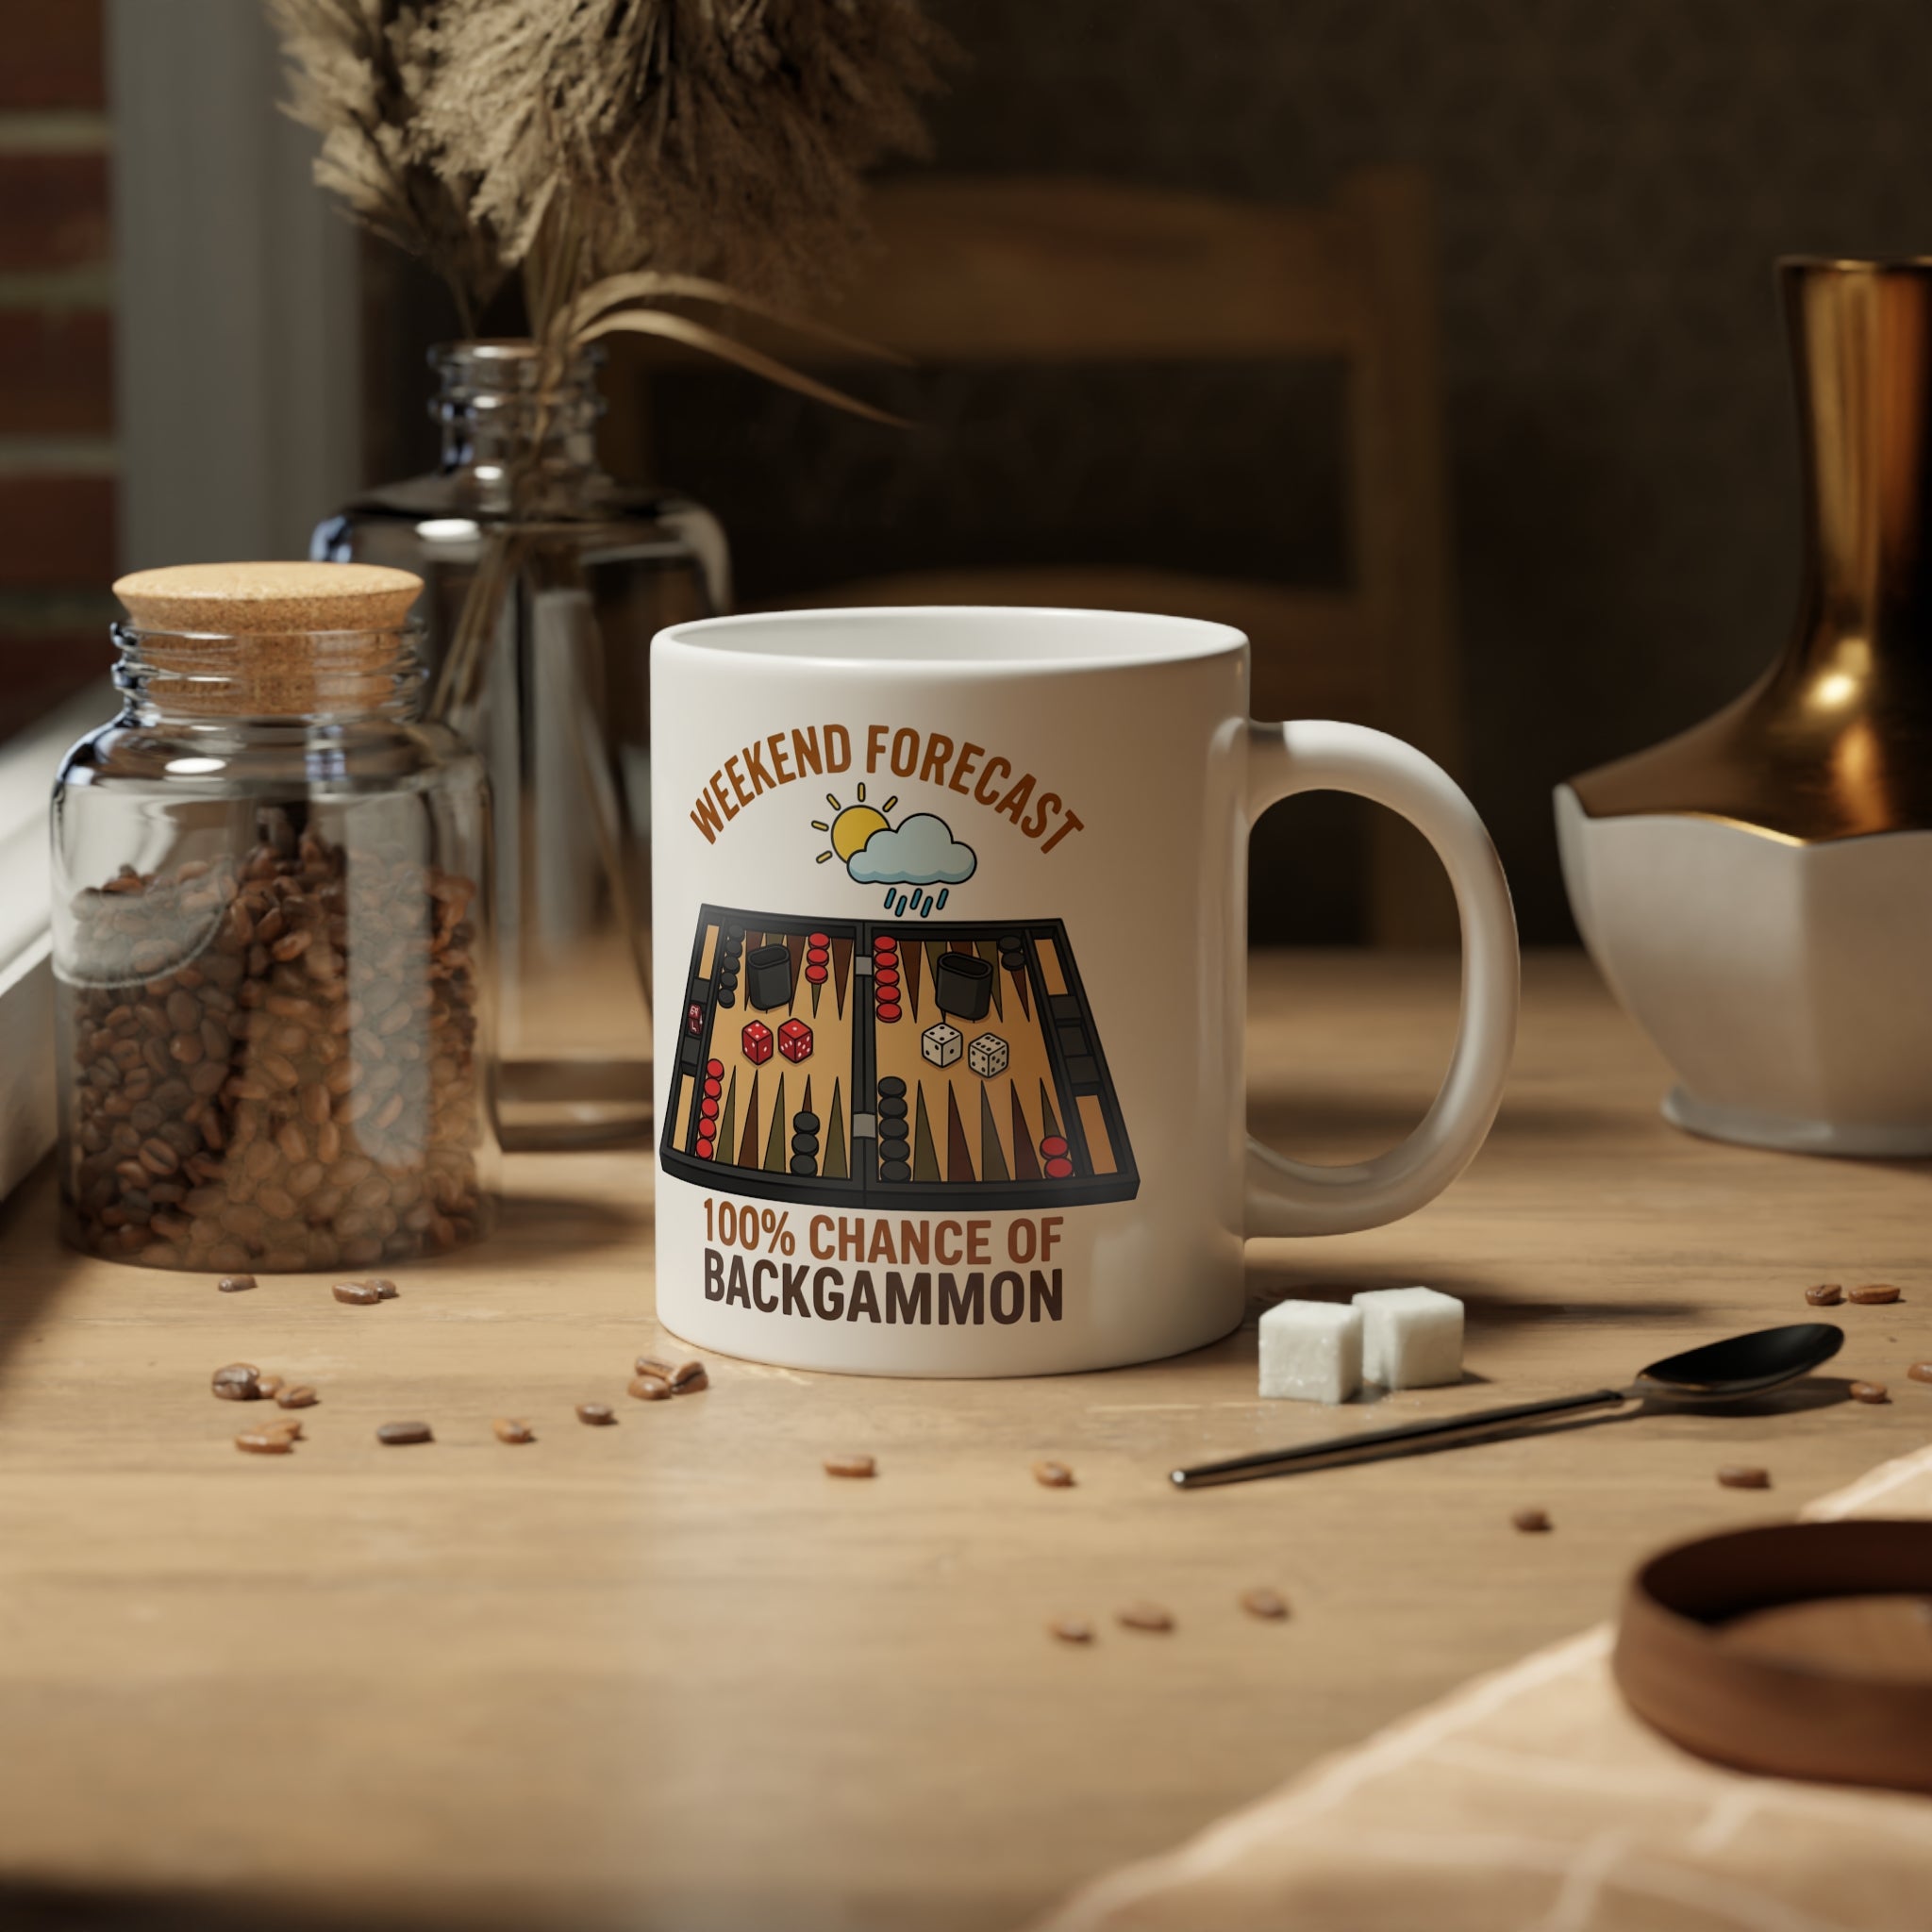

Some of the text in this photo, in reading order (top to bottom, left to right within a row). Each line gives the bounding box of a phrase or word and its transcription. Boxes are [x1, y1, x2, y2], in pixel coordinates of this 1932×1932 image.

[690, 724, 1085, 854] WEEKEND FORECAST
[704, 1197, 1064, 1266] 100% CHANCE OF
[704, 1247, 1063, 1325] BACKGAMMON
